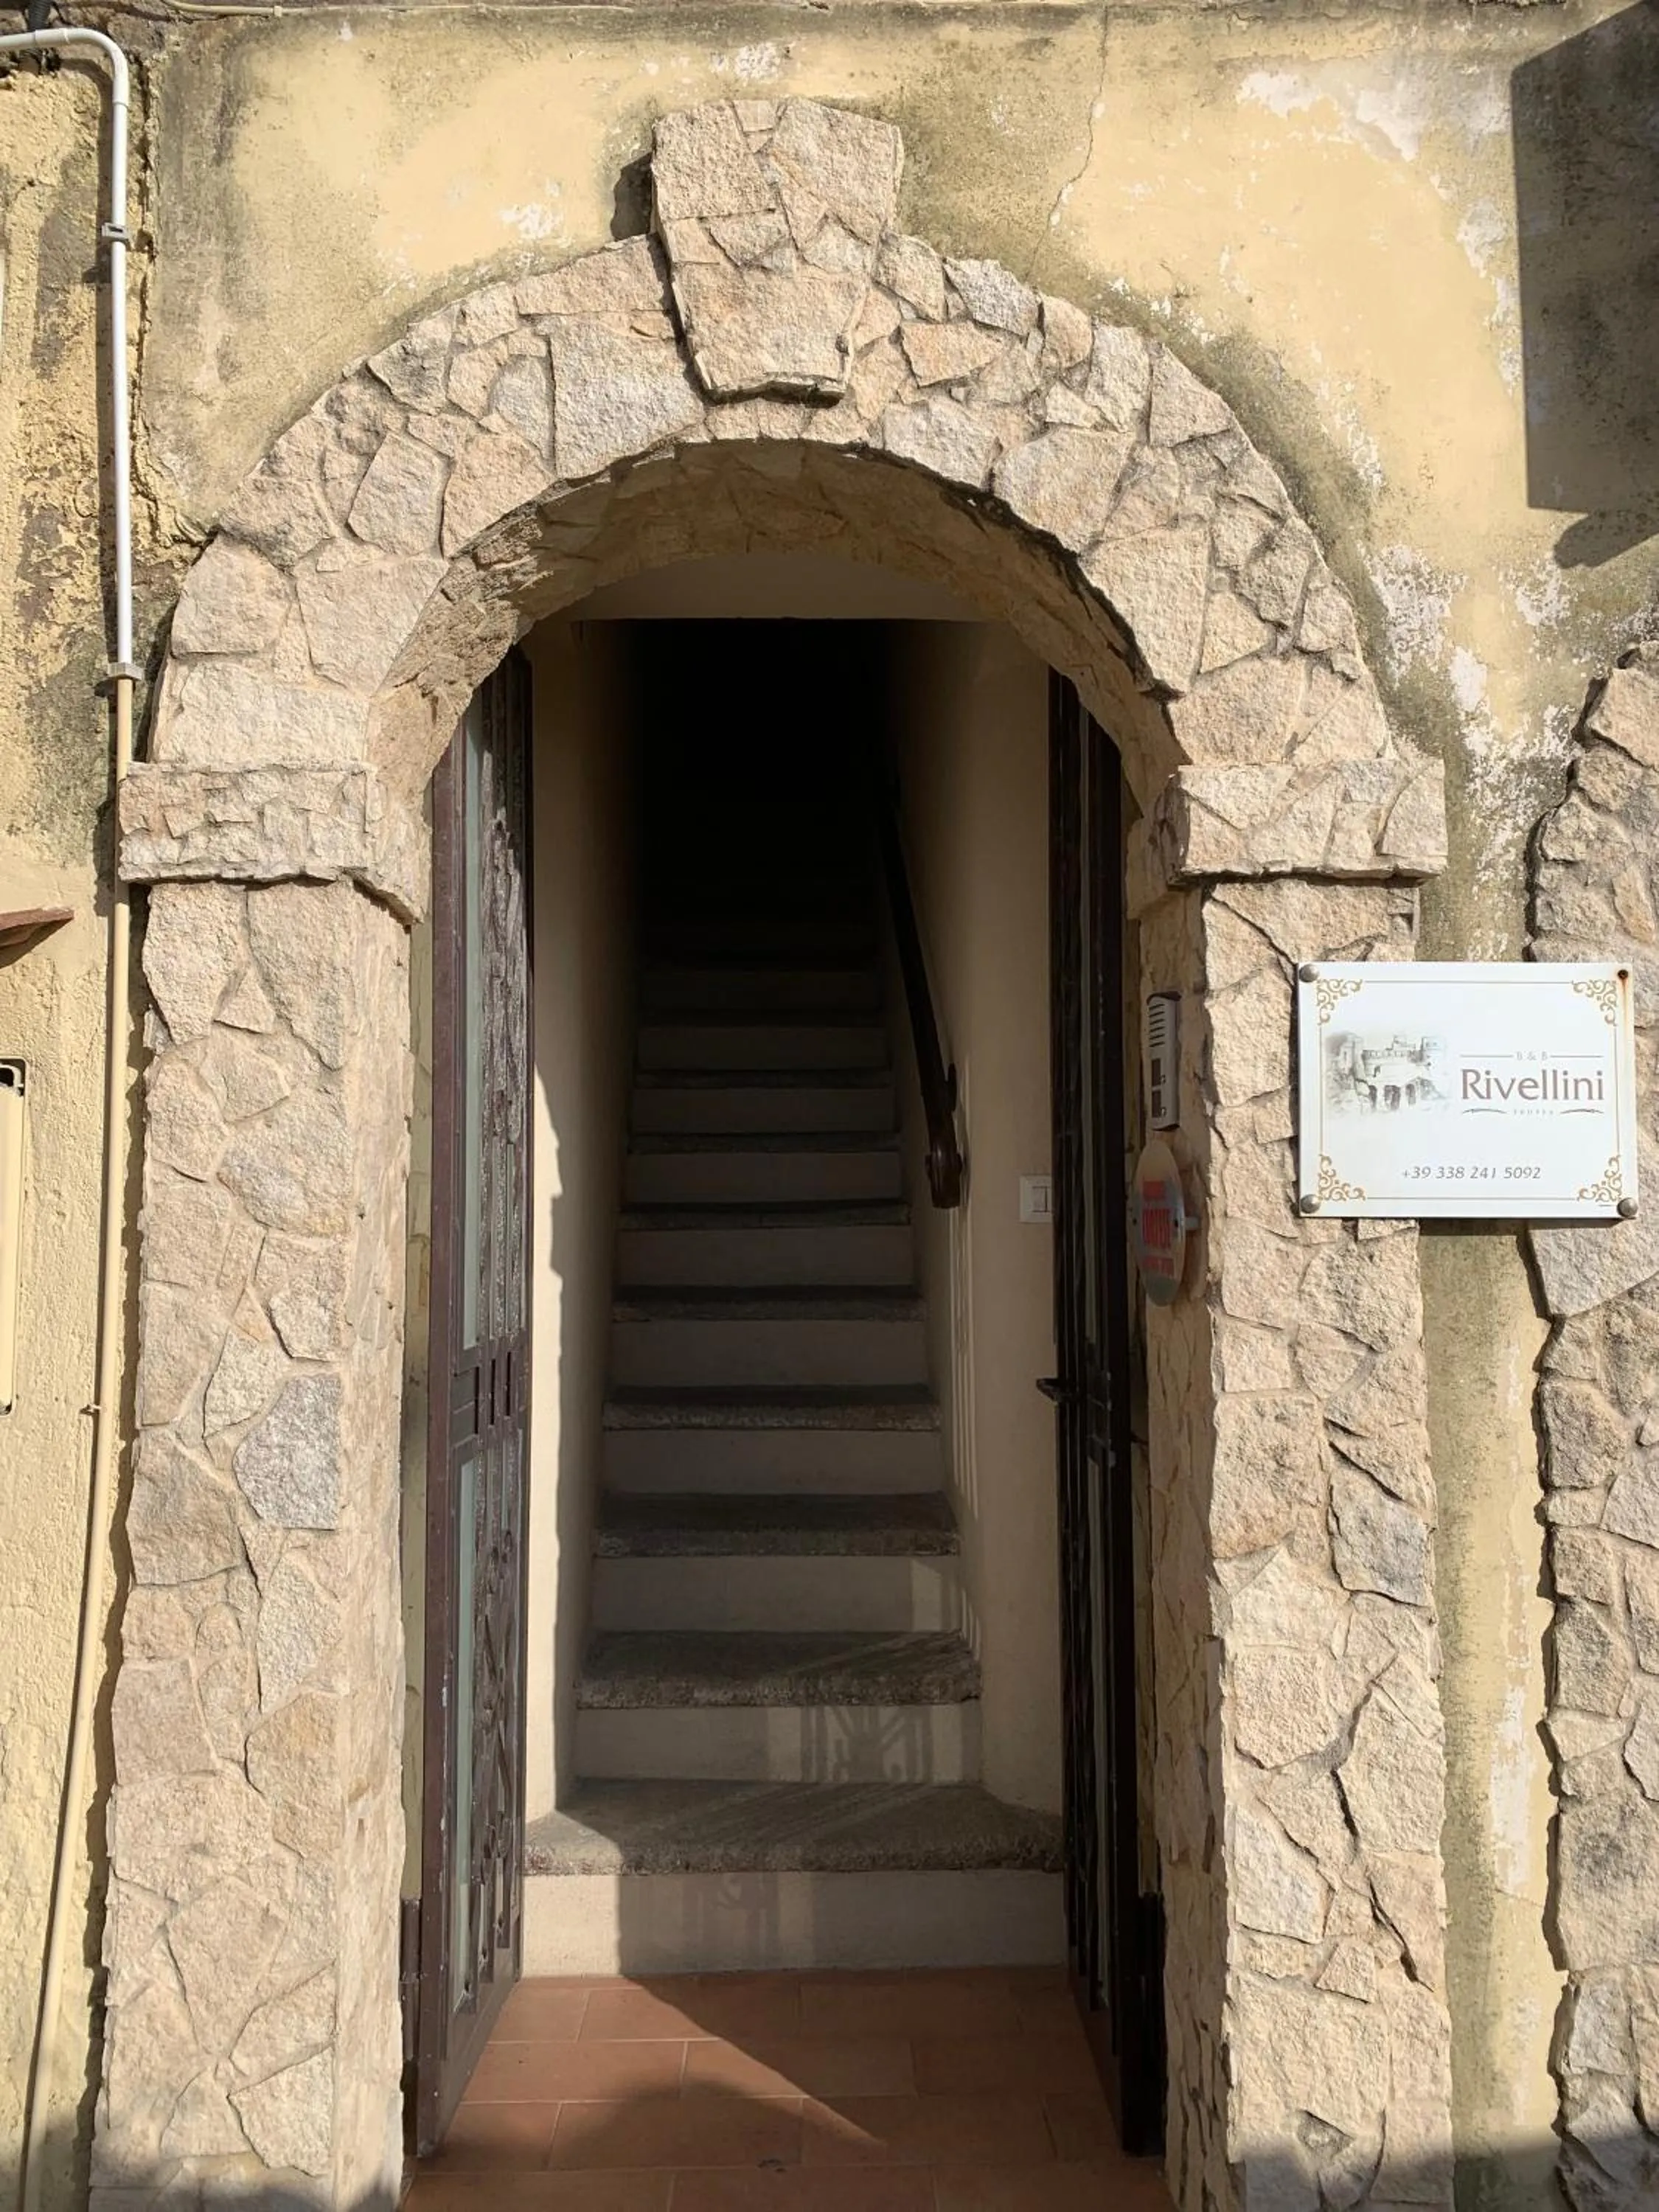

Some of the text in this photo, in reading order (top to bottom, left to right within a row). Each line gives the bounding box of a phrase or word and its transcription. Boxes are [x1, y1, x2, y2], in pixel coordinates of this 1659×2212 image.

[1461, 1068, 1604, 1101] Rivellini
[1402, 1166, 1541, 1179] +39 338 241 5092
